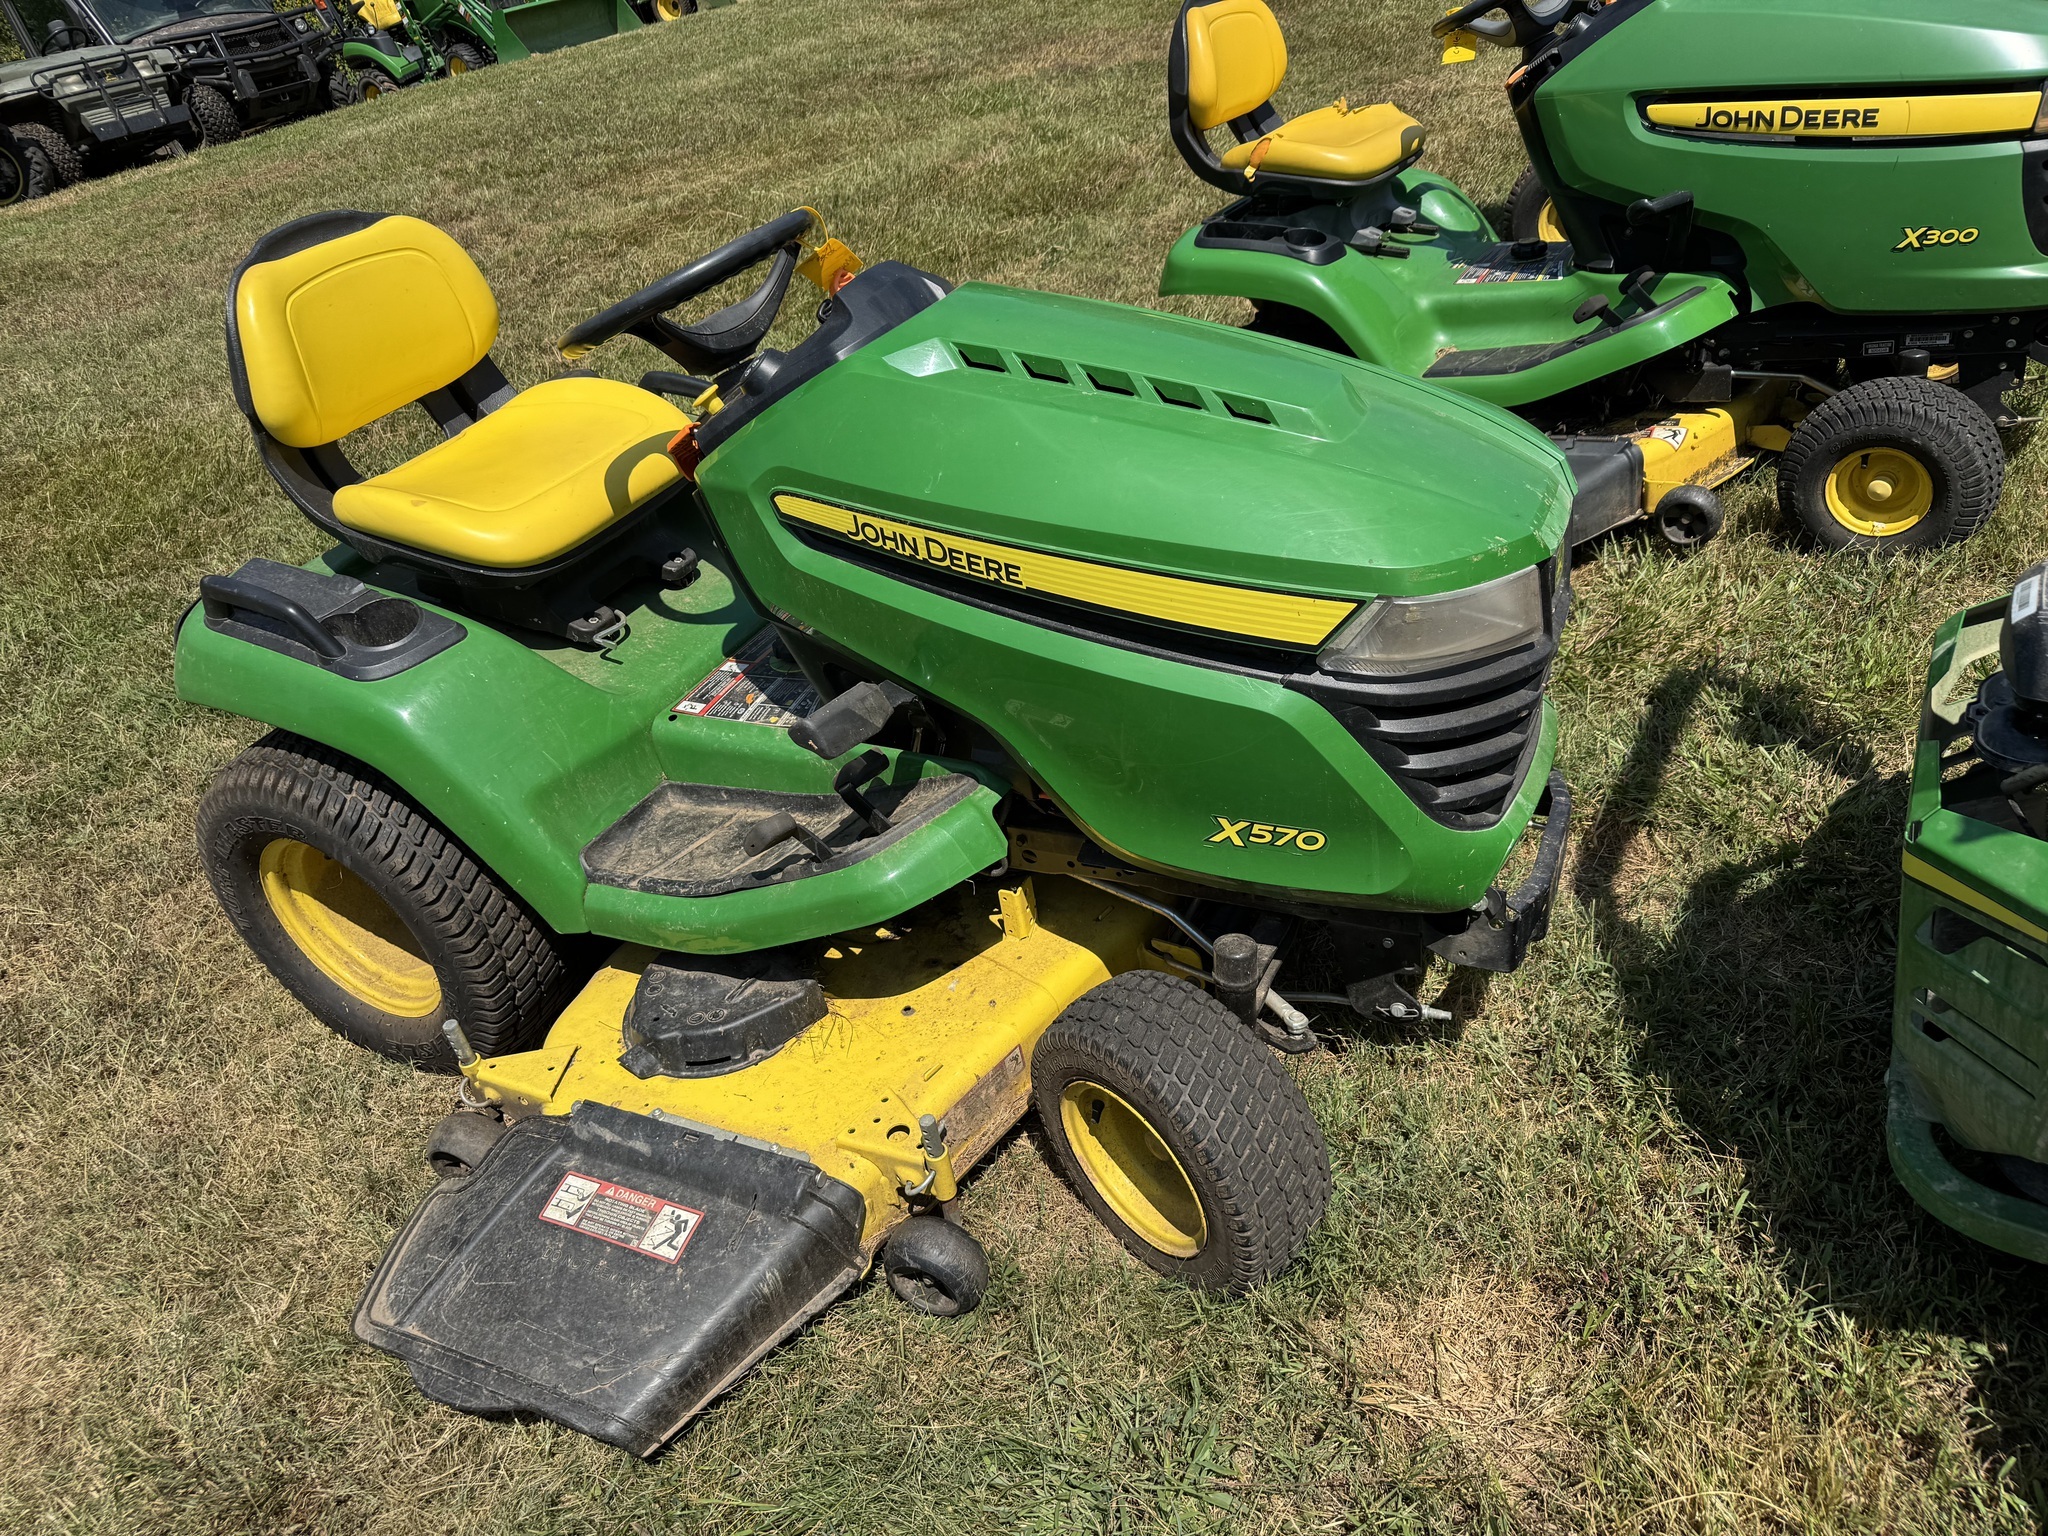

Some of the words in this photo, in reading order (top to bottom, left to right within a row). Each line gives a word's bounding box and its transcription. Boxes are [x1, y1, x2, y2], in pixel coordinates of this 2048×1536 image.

[1694, 106, 1774, 129] JOHN
[1780, 105, 1880, 128] DEERE
[1896, 226, 1980, 251] X300
[846, 514, 919, 557] JOHN
[926, 536, 1024, 586] DEERE
[214, 815, 308, 860] MASTER
[1209, 817, 1328, 853] X570
[1040, 1053, 1131, 1095] CARLISLE
[604, 1196, 629, 1207] ROTATING
[614, 1189, 657, 1208] DANGER
[541, 1246, 563, 1263] DO
[561, 1253, 593, 1270] NOT
[588, 1263, 650, 1292] REMOVE
